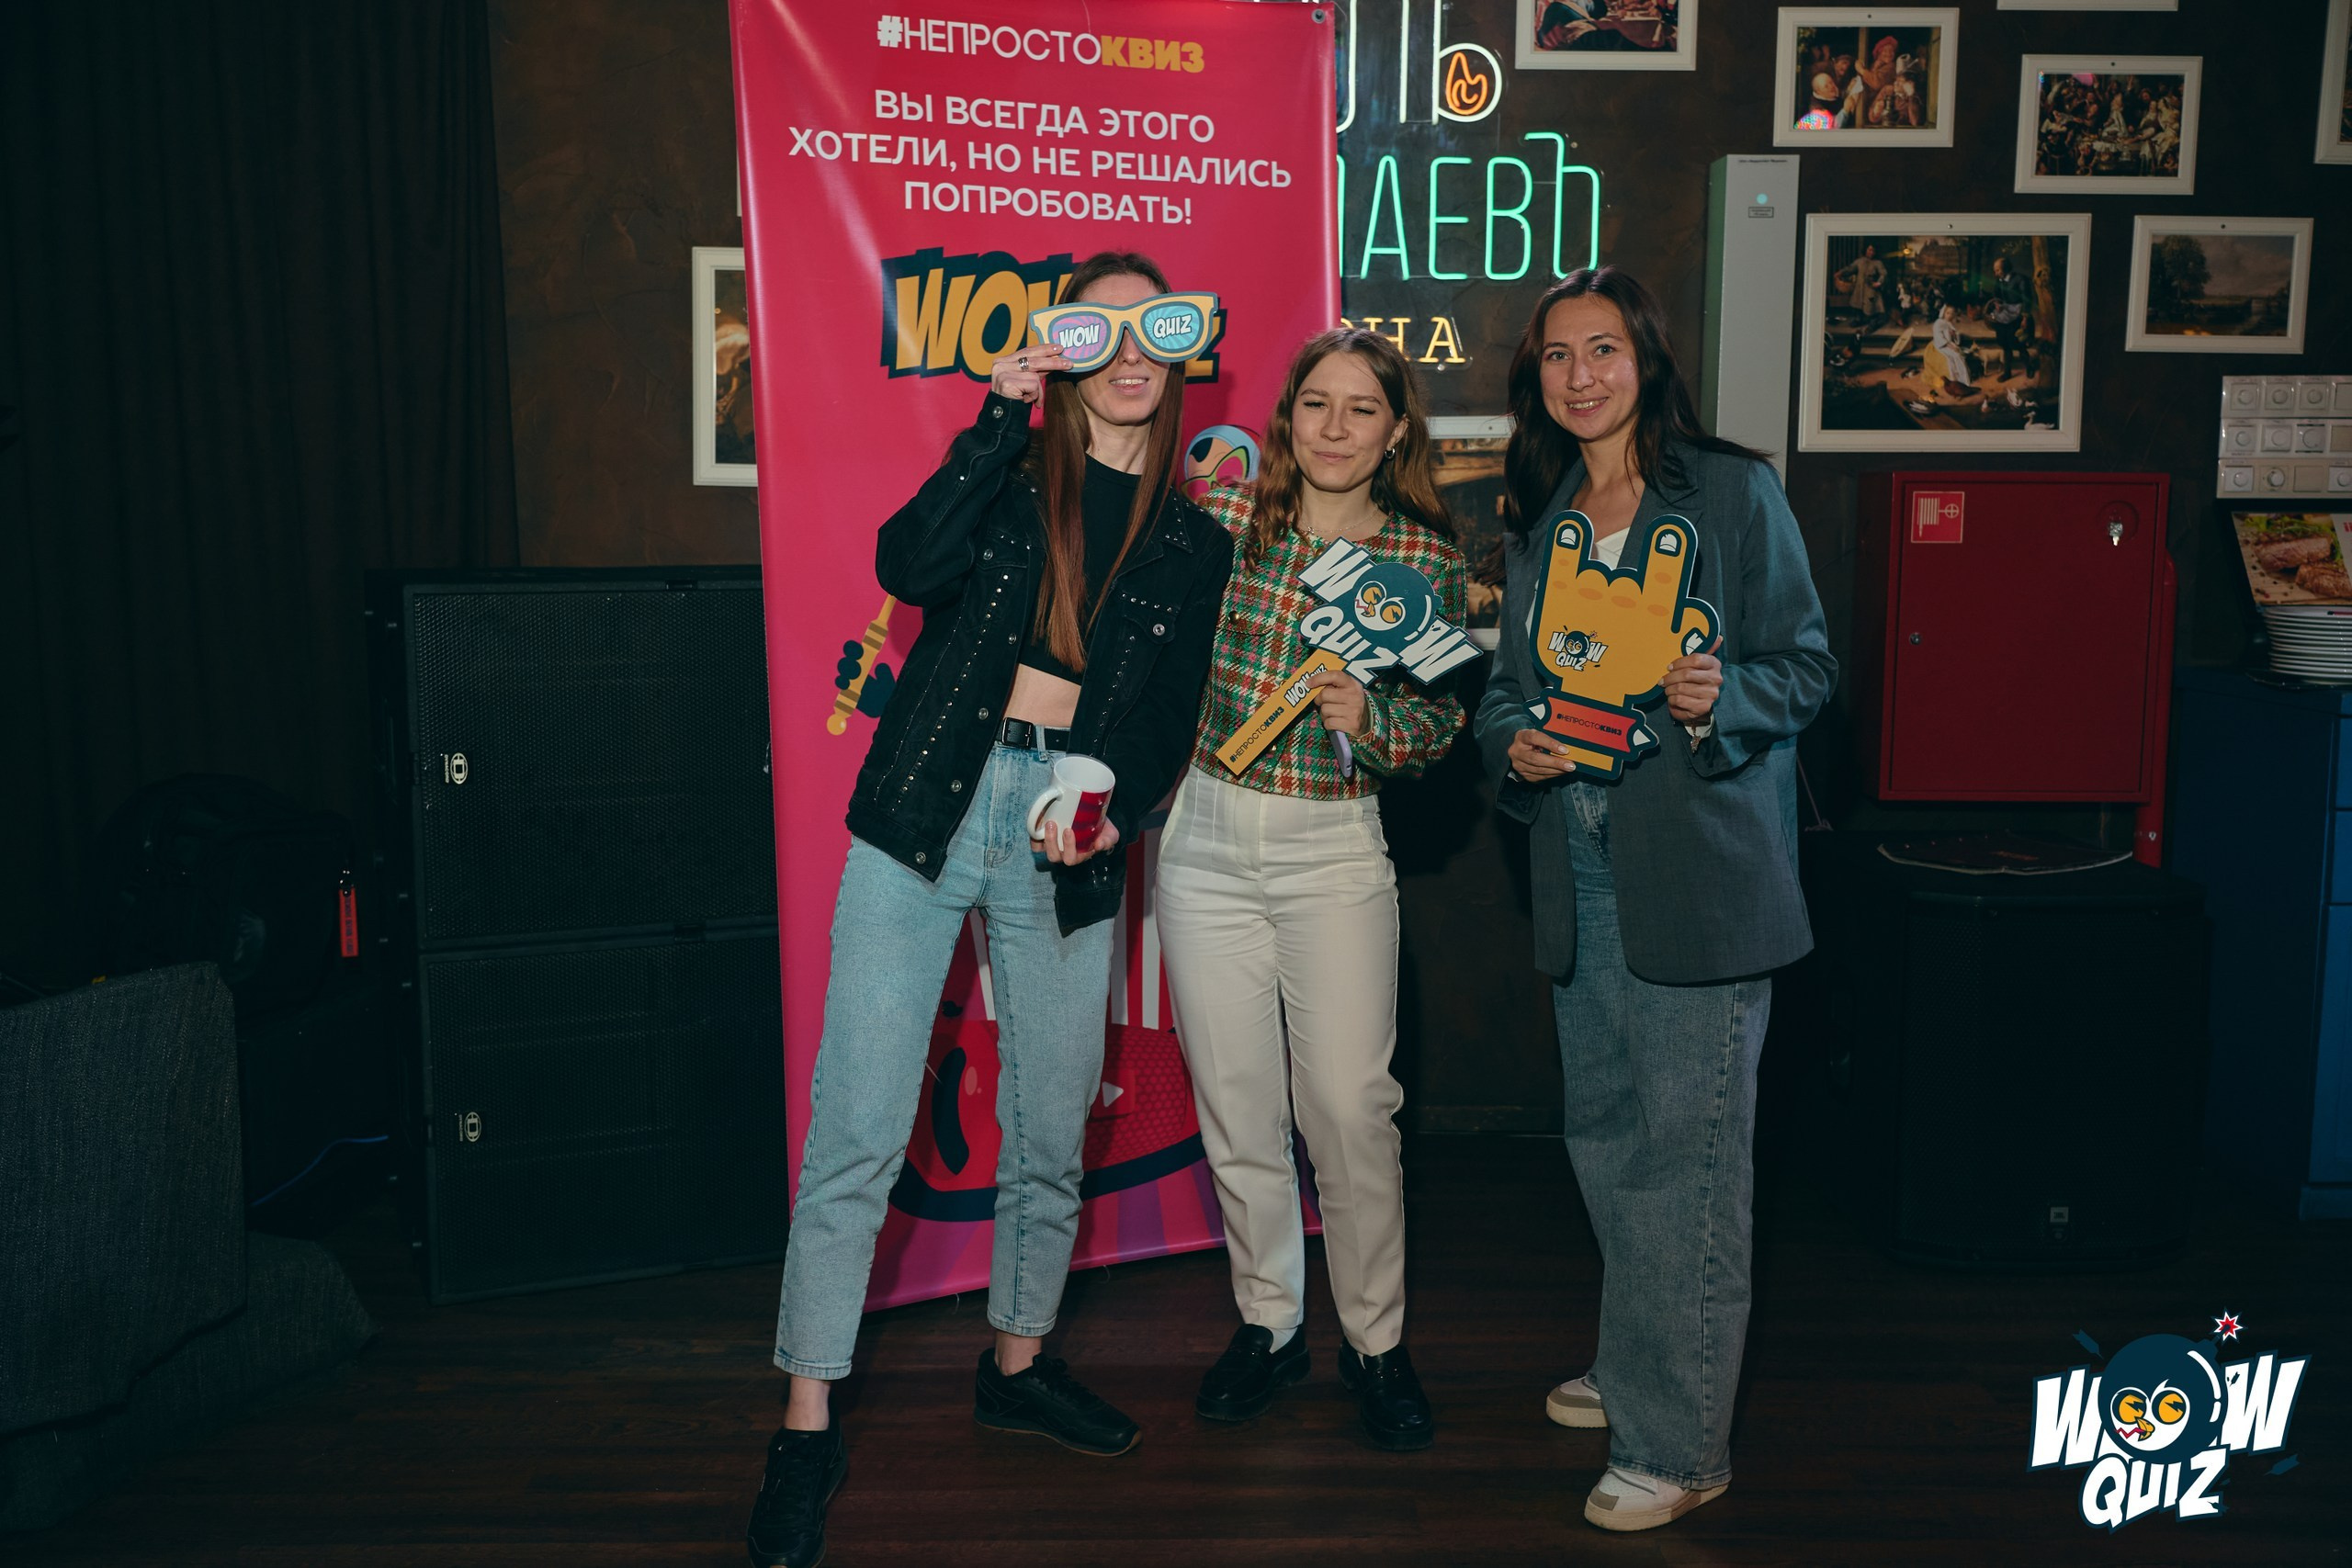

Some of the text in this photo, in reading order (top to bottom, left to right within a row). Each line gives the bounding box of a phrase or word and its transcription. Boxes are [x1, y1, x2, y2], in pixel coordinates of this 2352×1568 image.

[876, 15, 1205, 73] #НЕПРОСТОКВИЗ
[875, 89, 1215, 143] ВЫ ВСЕГДА ЭТОГО
[788, 127, 1291, 189] ХОТЕЛИ, НО НЕ РЕШАЛИСЬ
[904, 181, 1192, 225] ПОПРОБОВАТЬ!
[1059, 314, 1193, 348] WOW QUIZ
[1300, 605, 1400, 685] QUIZ
[1555, 652, 1587, 671] QUIZ
[1229, 706, 1284, 762] #НЕПРОСТОКВИЗ
[1556, 713, 1622, 736] #НЕПРОСТОКВИЗ
